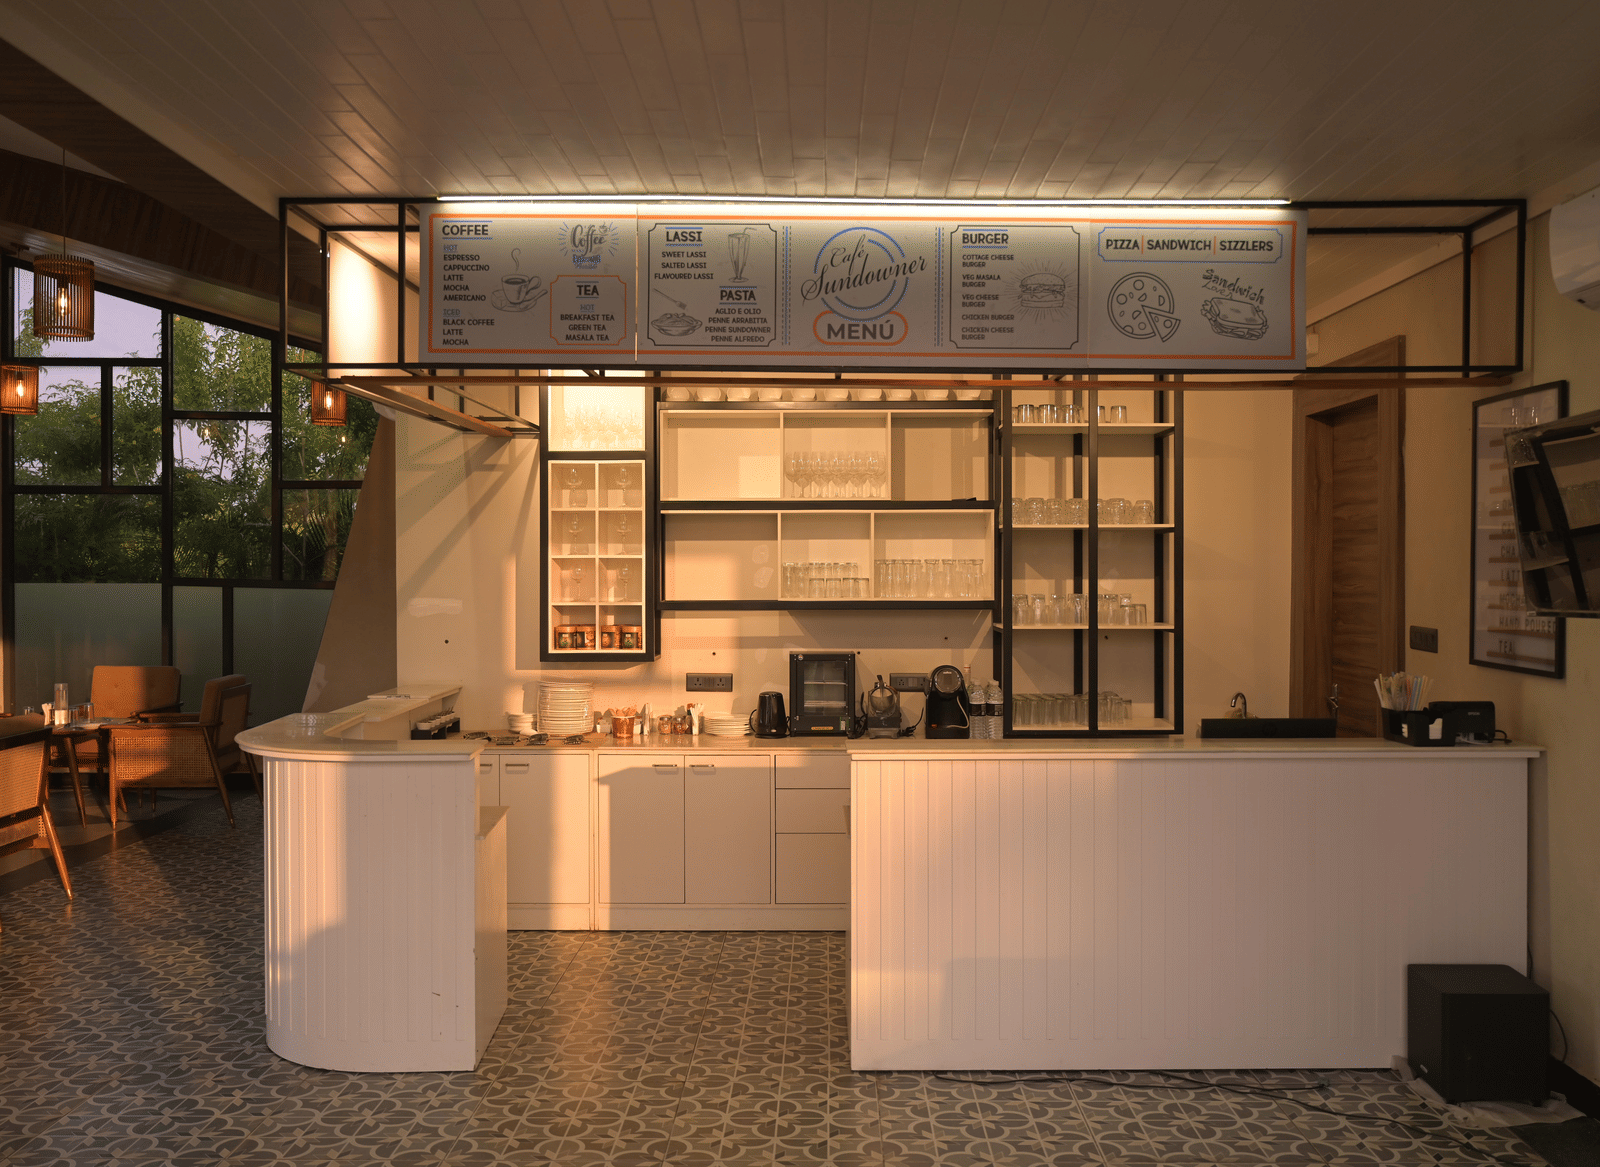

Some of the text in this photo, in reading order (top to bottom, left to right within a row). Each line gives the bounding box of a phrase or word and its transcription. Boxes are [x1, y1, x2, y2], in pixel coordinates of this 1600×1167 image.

[442, 224, 488, 236] COFFEE
[571, 224, 606, 257] Coffee
[666, 231, 702, 242] LASSI
[962, 233, 1009, 244] BURGER
[1106, 239, 1273, 251] PIZZA SANDWICH SIZZLERS
[830, 234, 865, 276] Café
[801, 253, 927, 306] Sundowner
[577, 285, 599, 296] TEA
[1202, 268, 1264, 305] Sandwich
[720, 290, 756, 301] PASTA
[828, 320, 894, 340] MENÚ
[1501, 570, 1520, 582] LATT
